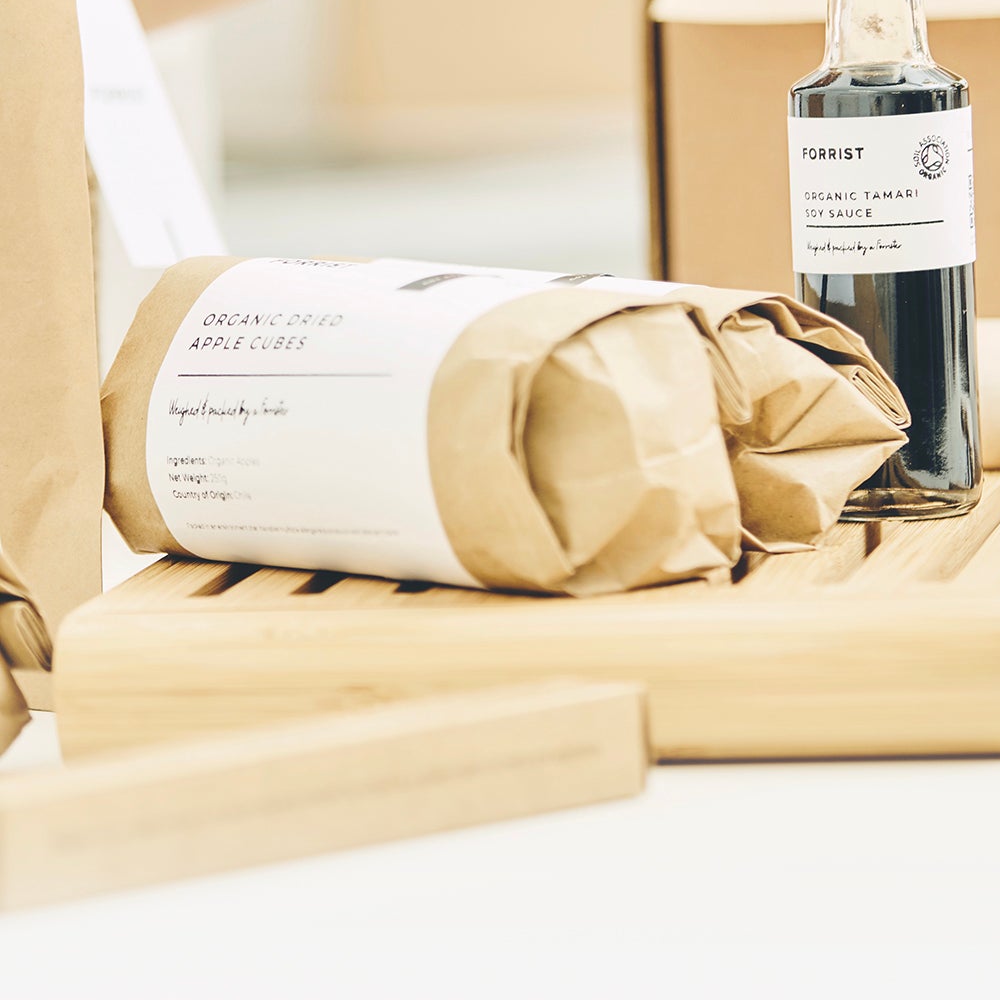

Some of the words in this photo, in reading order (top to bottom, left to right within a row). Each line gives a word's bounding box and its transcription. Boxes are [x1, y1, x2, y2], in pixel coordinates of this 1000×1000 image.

[802, 147, 864, 160] FORRIST
[913, 149, 921, 167] SOIL
[919, 134, 950, 164] ASSOCIATION
[804, 191, 857, 201] ORGANIC
[864, 188, 919, 200] TAMARI
[805, 208, 823, 218] SOY
[829, 208, 872, 218] SAUCE
[203, 313, 283, 327] ORGANIC
[287, 314, 344, 328] DRIED
[188, 336, 245, 351] APPLE
[249, 336, 308, 351] CUBES
[166, 455, 206, 467] Ingredients:
[168, 473, 181, 482] Net
[182, 473, 208, 485] Weight:
[172, 489, 200, 501] Country
[202, 490, 208, 499] of
